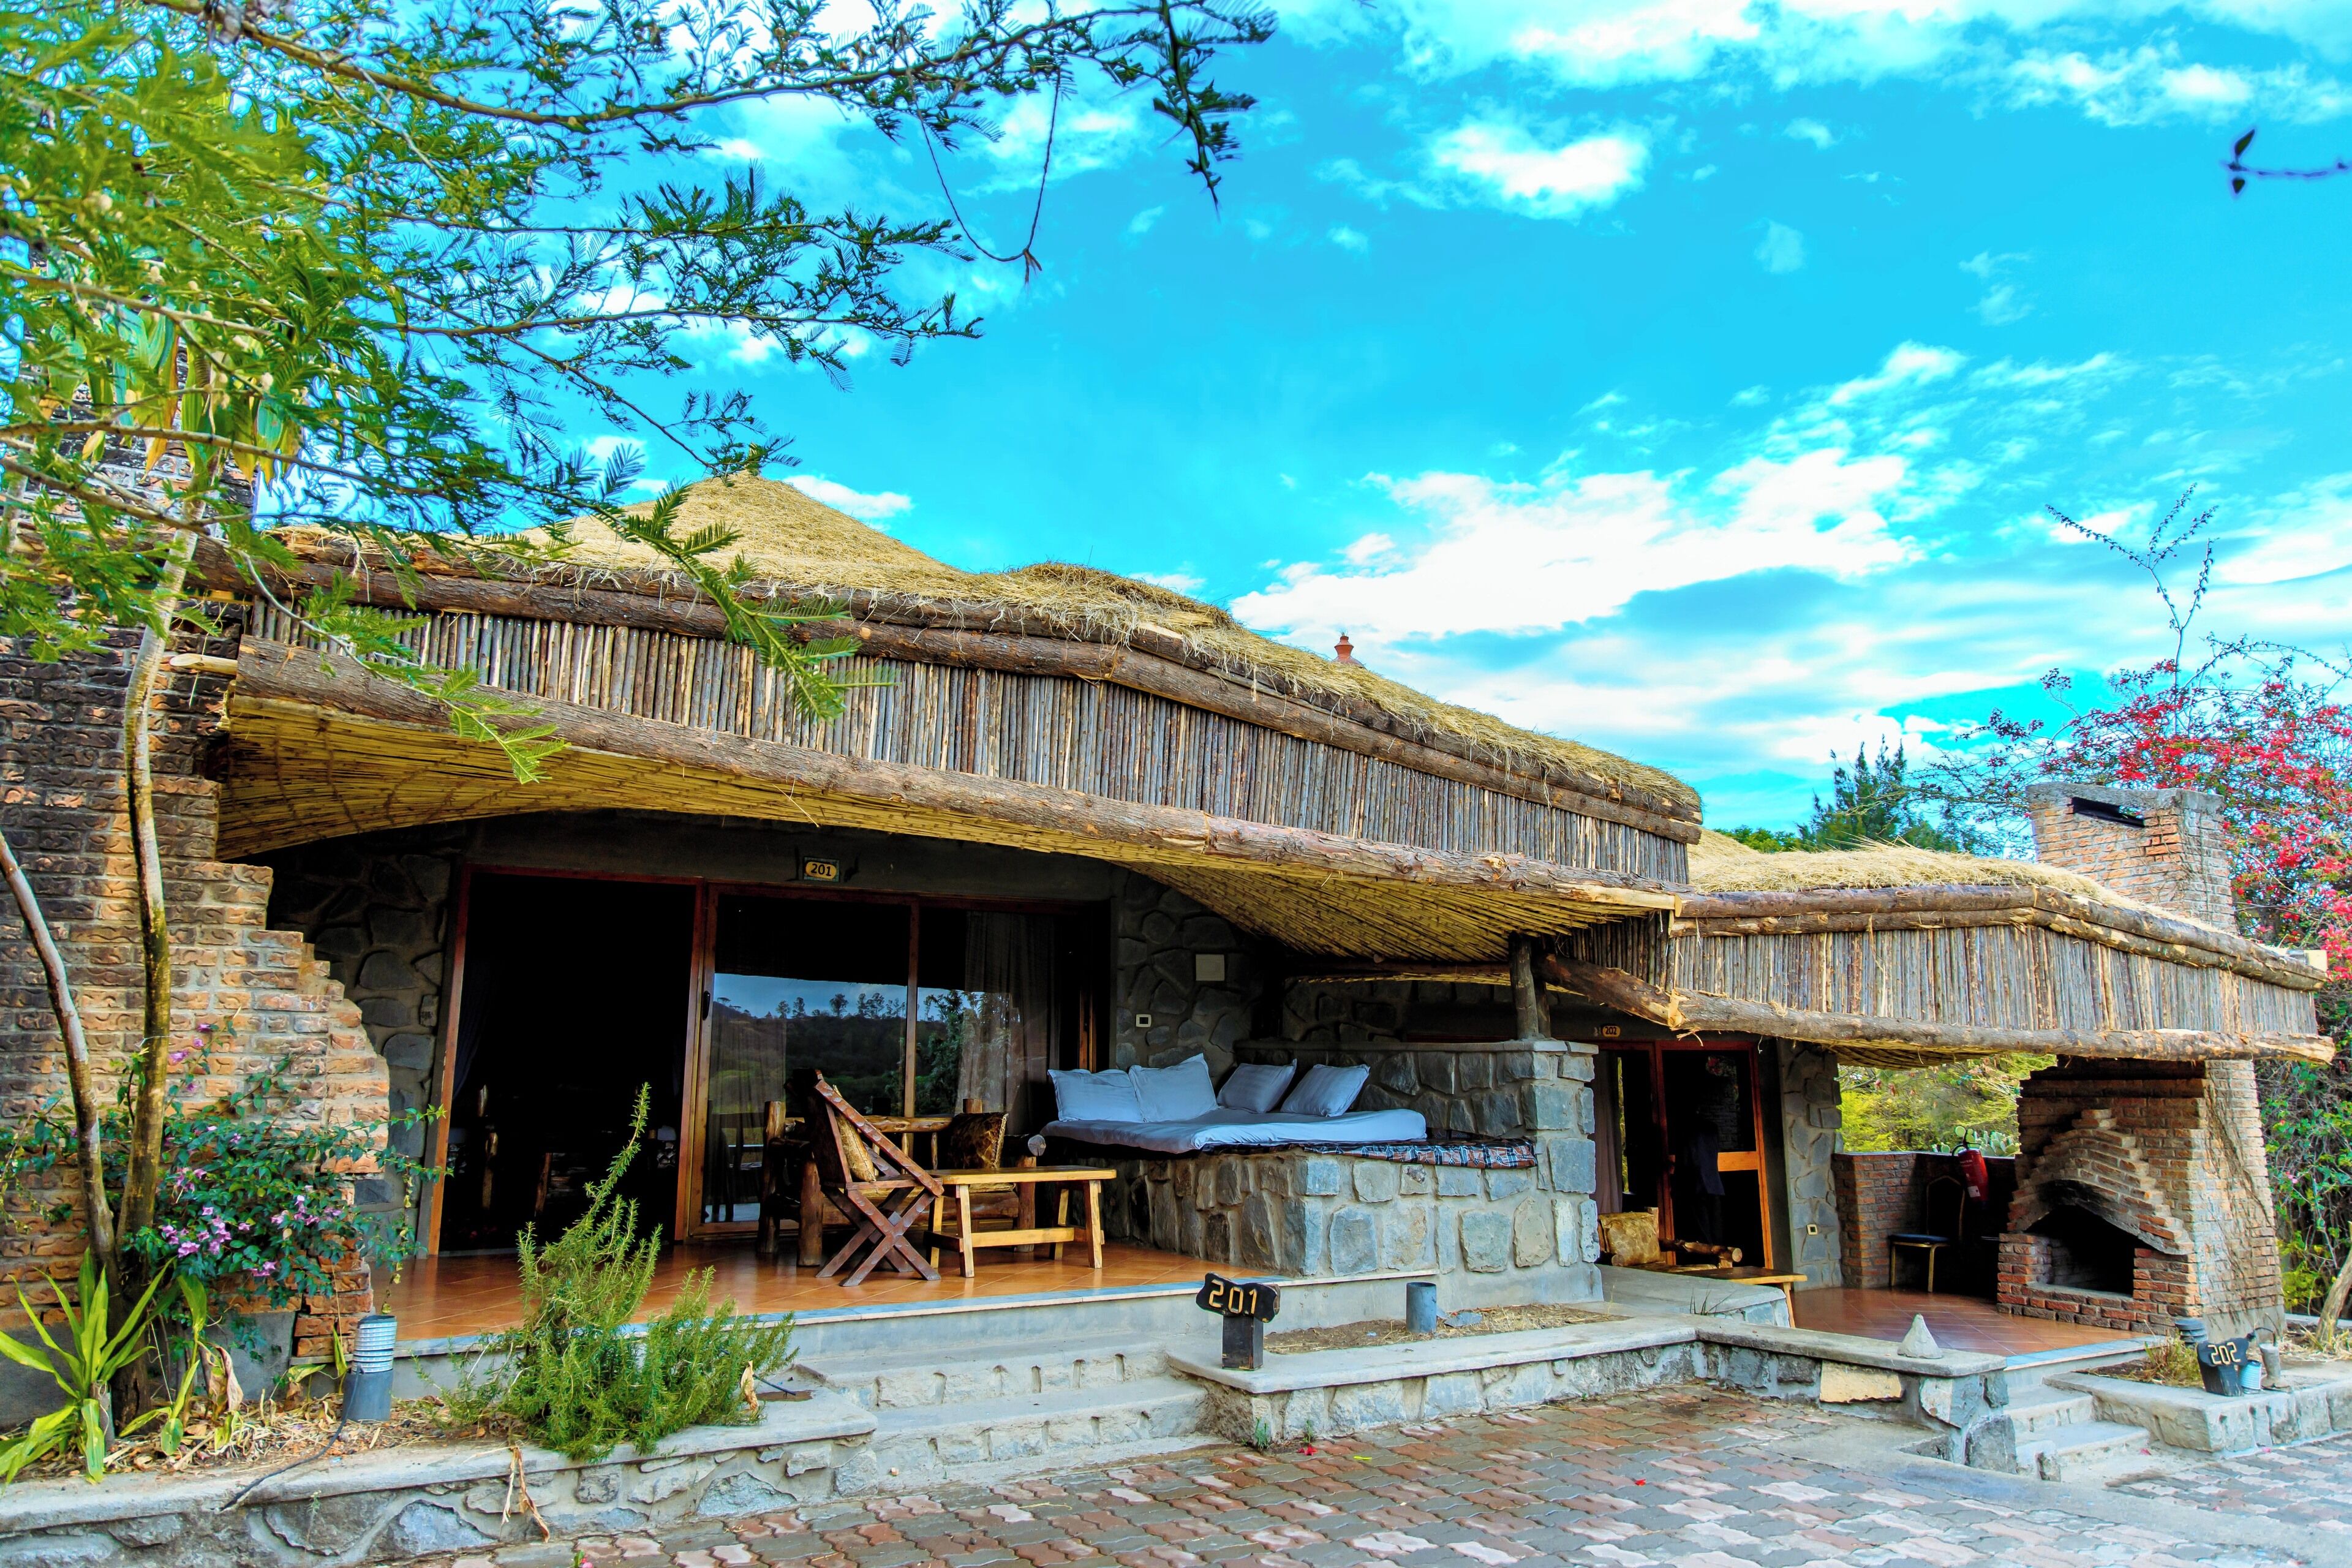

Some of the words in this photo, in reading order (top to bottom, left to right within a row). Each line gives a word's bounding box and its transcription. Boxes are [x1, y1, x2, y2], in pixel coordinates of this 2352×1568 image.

[811, 863, 832, 876] 201
[1605, 1026, 1617, 1035] 202
[1208, 1279, 1257, 1314] 201
[2207, 1341, 2241, 1365] 202
